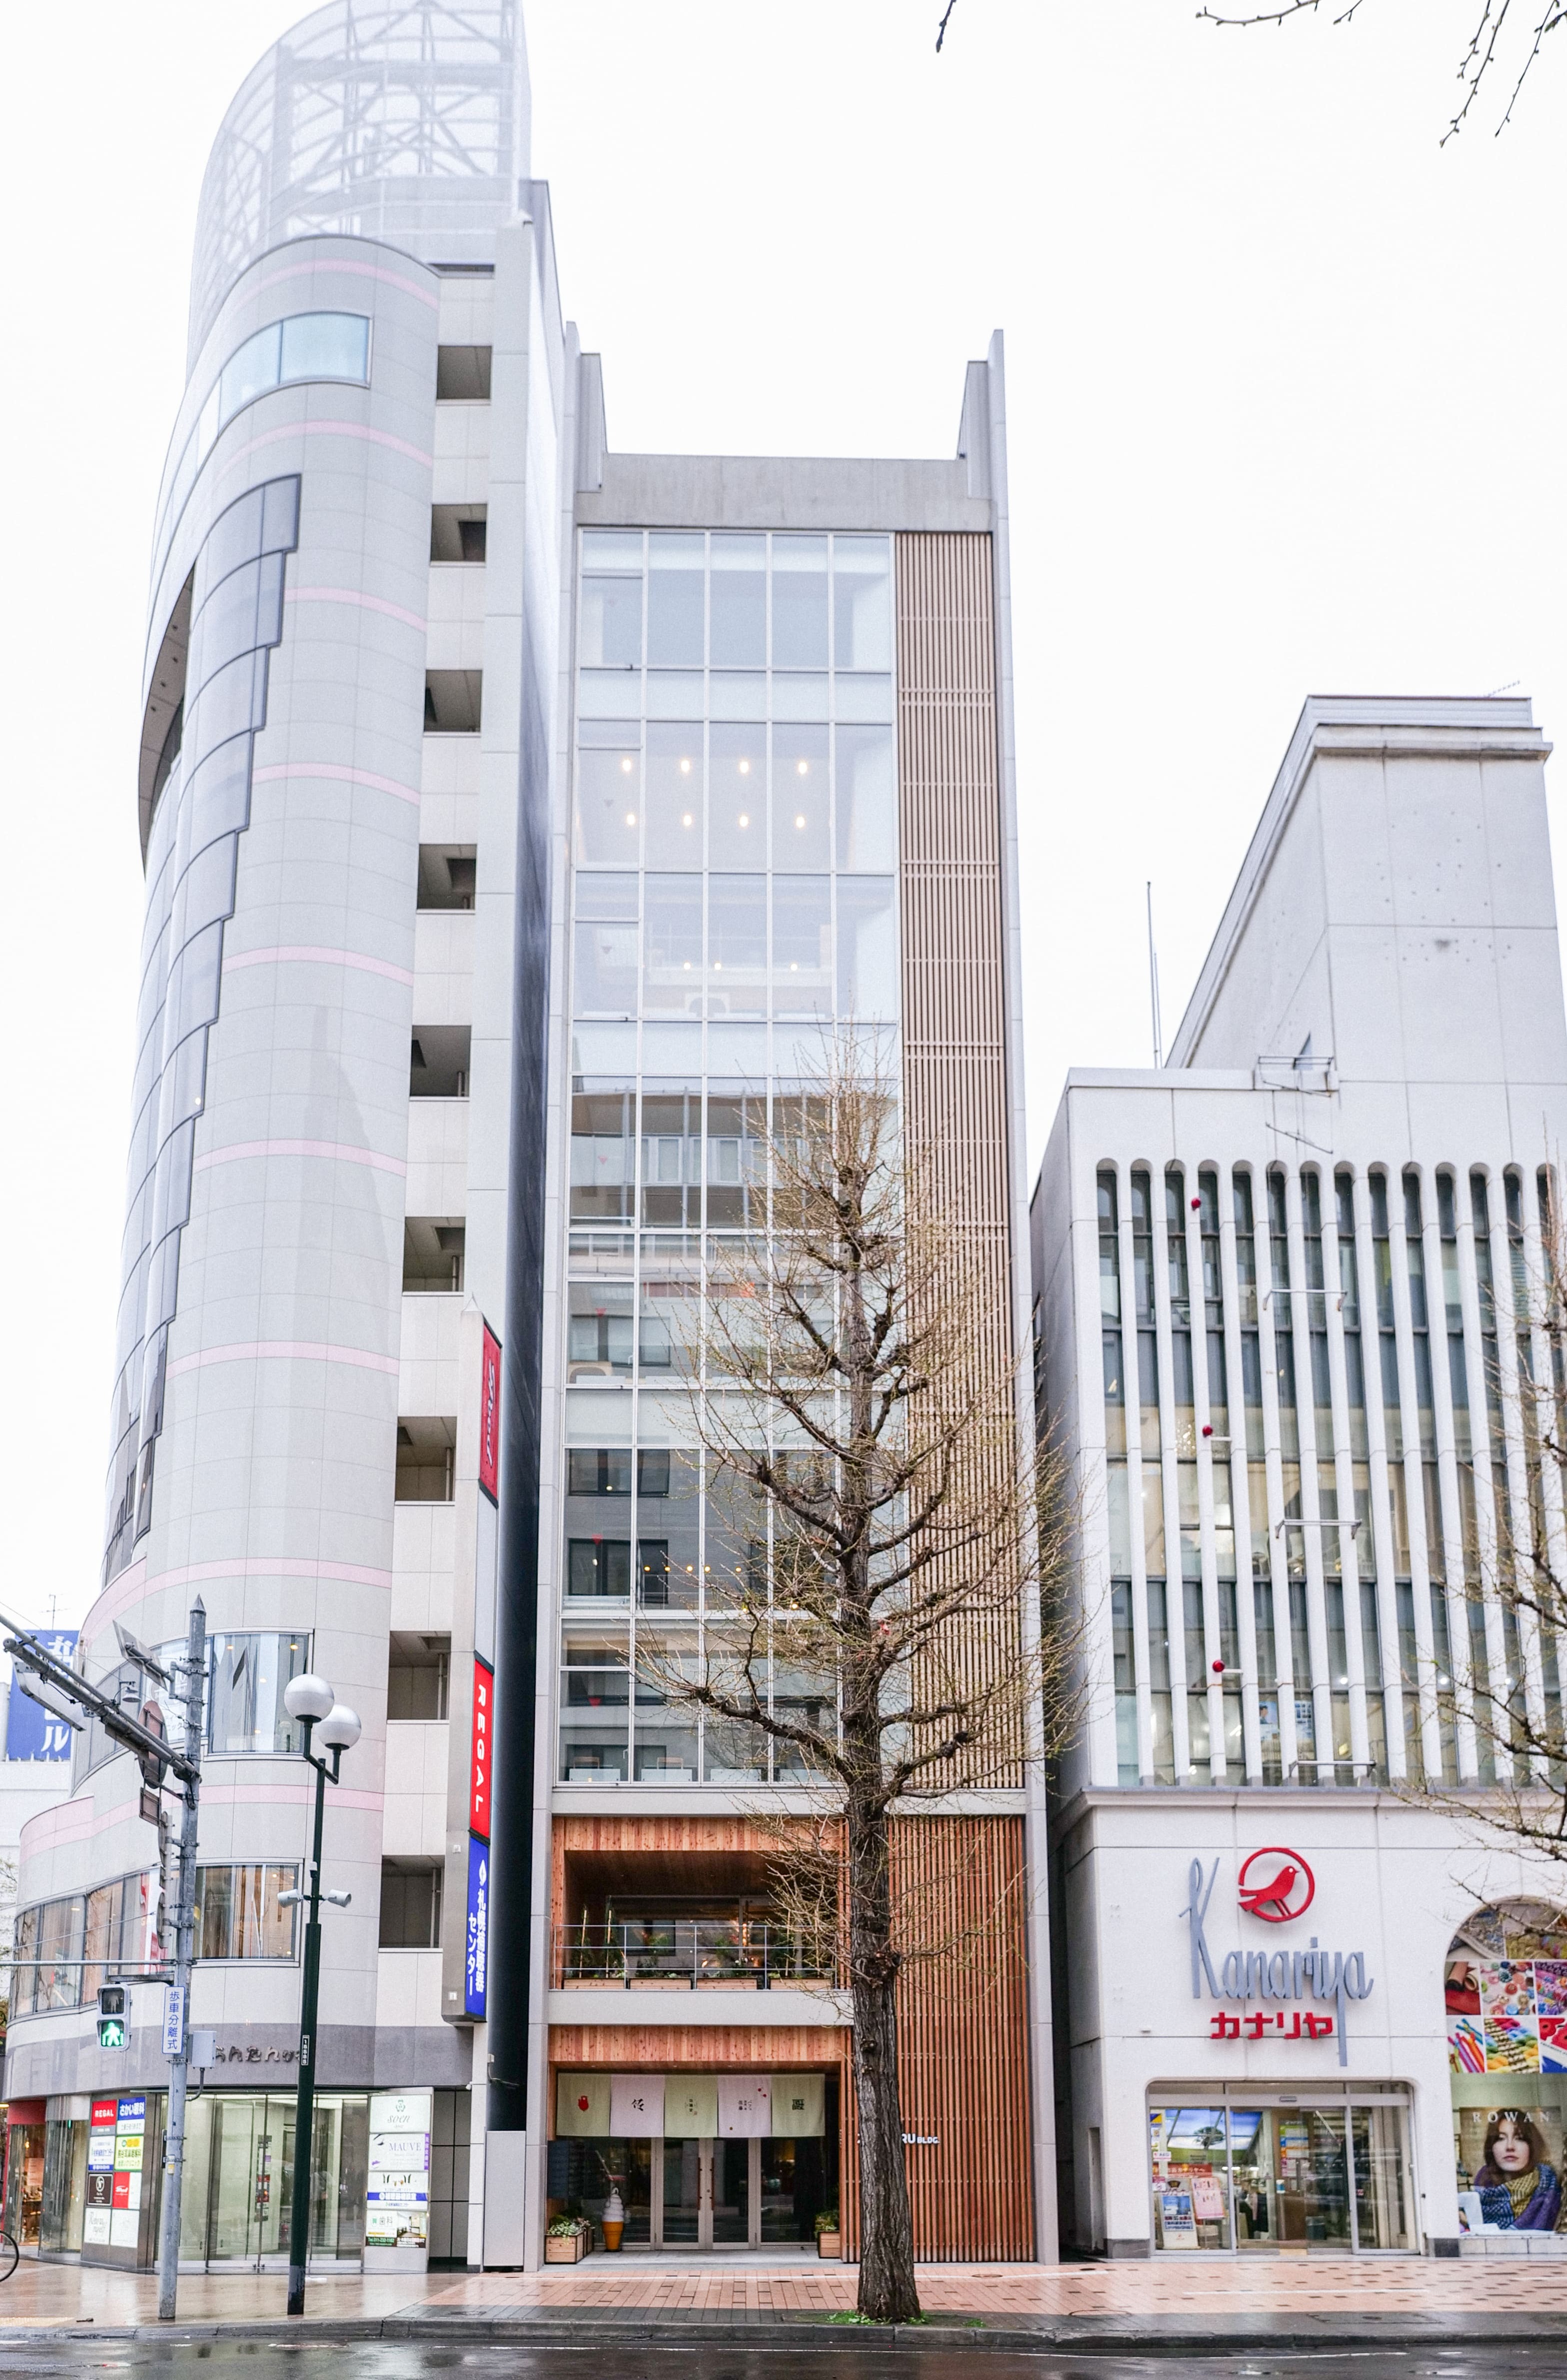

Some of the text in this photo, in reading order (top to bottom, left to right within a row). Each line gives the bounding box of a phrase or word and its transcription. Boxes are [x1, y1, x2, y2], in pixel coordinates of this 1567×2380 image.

[475, 1683, 486, 1813] REGAL
[467, 1912, 477, 1996] センター
[1178, 1857, 1374, 2067] Kanariya
[167, 1991, 179, 2050] 歩車分離式
[1210, 2012, 1333, 2039] カナリヤ
[94, 2109, 114, 2118] REGAL
[119, 2102, 144, 2116] さかい眼科
[1473, 2111, 1549, 2123] ROWAN
[389, 2143, 421, 2151] MAUVE
